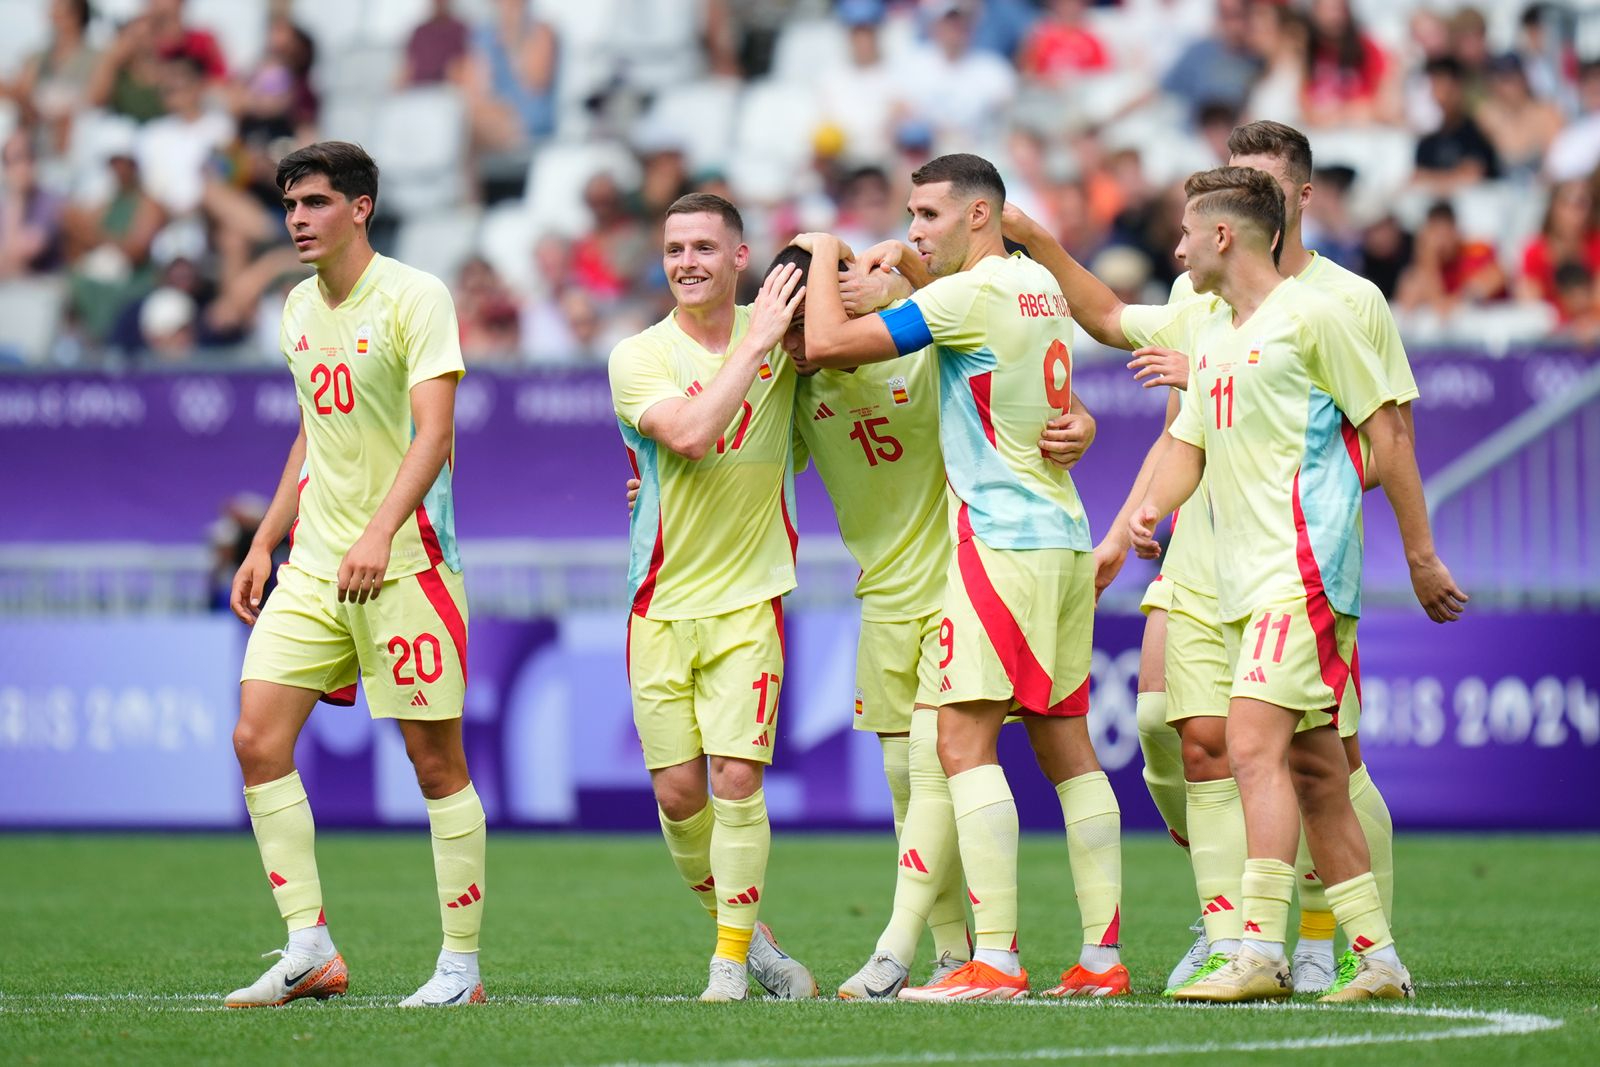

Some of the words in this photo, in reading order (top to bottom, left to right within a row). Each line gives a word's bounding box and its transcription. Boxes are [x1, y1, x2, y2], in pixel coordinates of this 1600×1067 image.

[1018, 293, 1054, 317] ABEL
[310, 363, 354, 414] 20
[1041, 338, 1070, 458] 9
[1210, 376, 1233, 430] 11
[849, 416, 903, 467] 15
[387, 632, 443, 685] 20
[939, 617, 954, 669] 9
[1253, 613, 1291, 663] 11
[752, 672, 780, 725] 17
[1452, 674, 1600, 747] 2024
